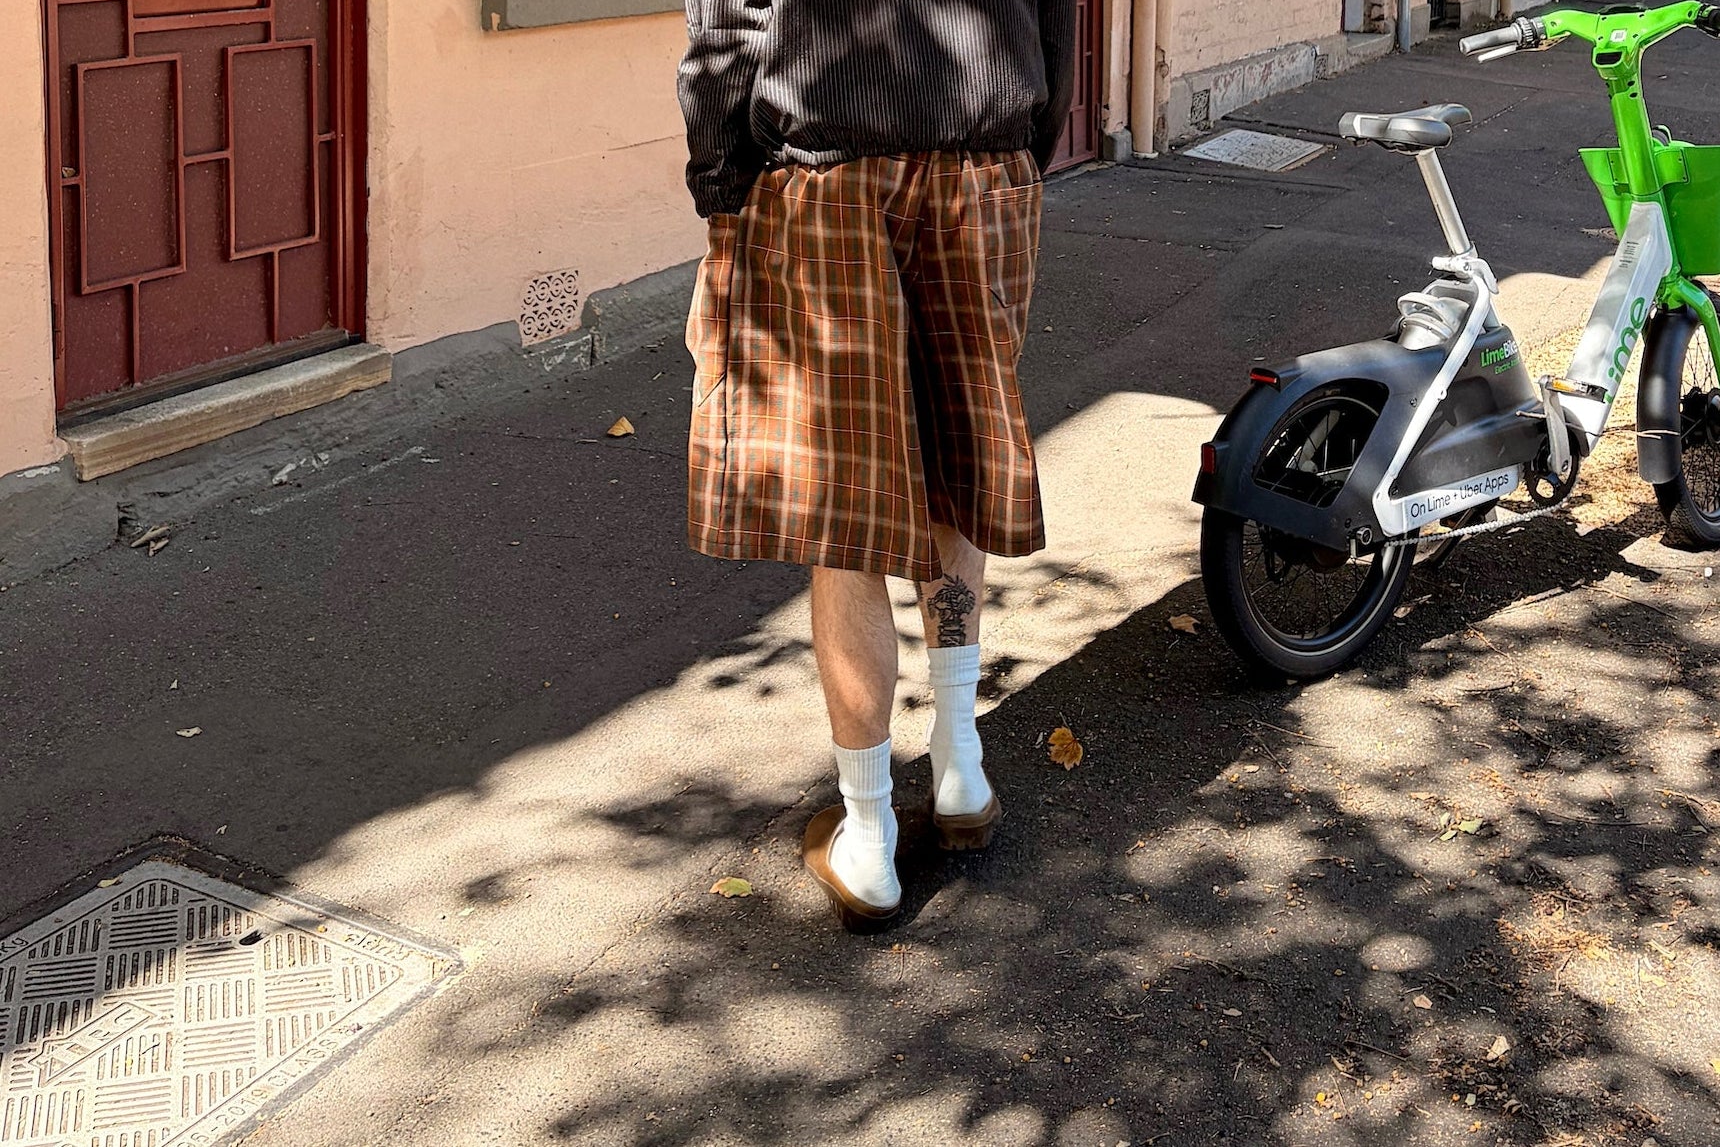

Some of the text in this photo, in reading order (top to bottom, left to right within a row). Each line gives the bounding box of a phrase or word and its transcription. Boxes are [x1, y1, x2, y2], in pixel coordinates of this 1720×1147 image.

[1410, 502, 1426, 518] On
[1427, 494, 1451, 512] Lime
[1460, 483, 1482, 500] Uber
[1484, 473, 1509, 493] Apps
[267, 1039, 338, 1087] CLASS
